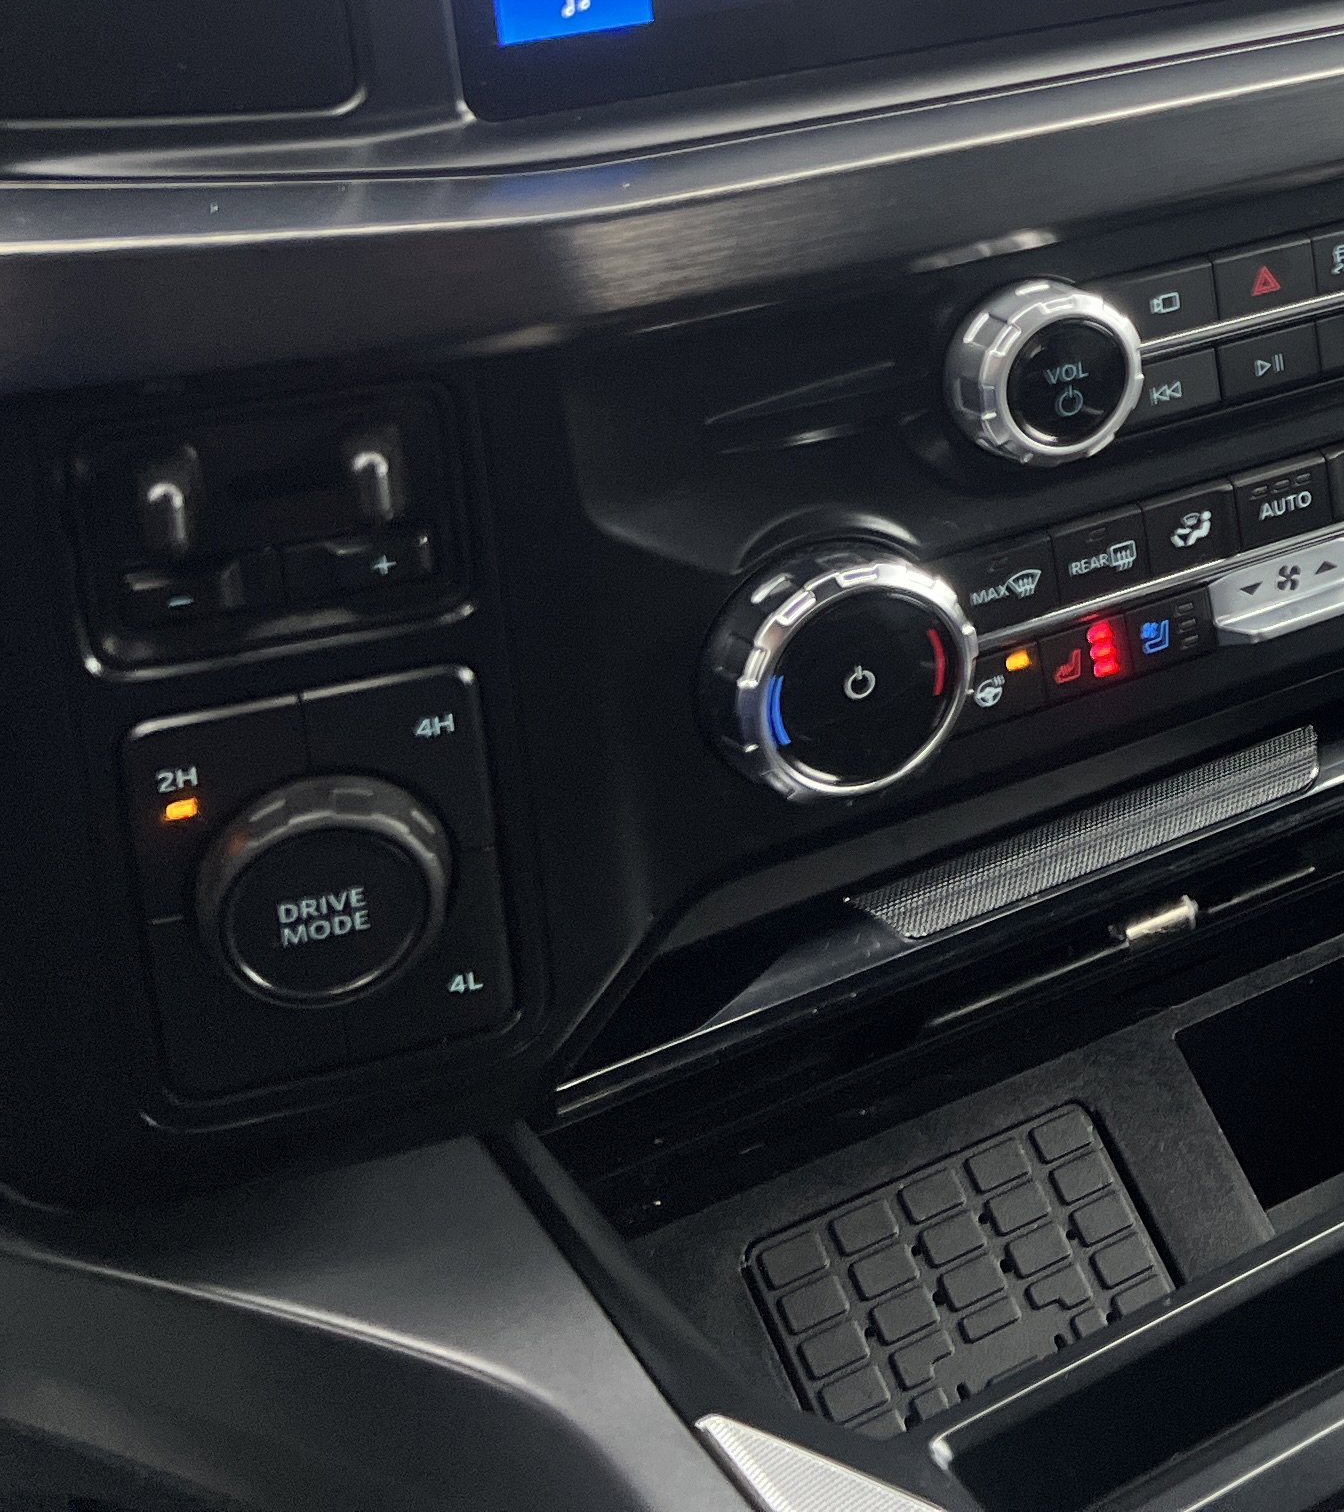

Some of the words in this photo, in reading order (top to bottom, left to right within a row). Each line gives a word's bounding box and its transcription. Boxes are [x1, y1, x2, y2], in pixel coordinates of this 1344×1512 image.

[1045, 361, 1089, 386] VOL
[1258, 490, 1313, 522] AUTO
[1069, 554, 1109, 577] REAR
[969, 583, 1010, 607] MAX
[414, 713, 455, 741] 4H
[155, 765, 198, 793] 2H
[277, 886, 367, 925] DRIVE
[281, 908, 371, 947] MODE
[447, 972, 484, 993] 4L
